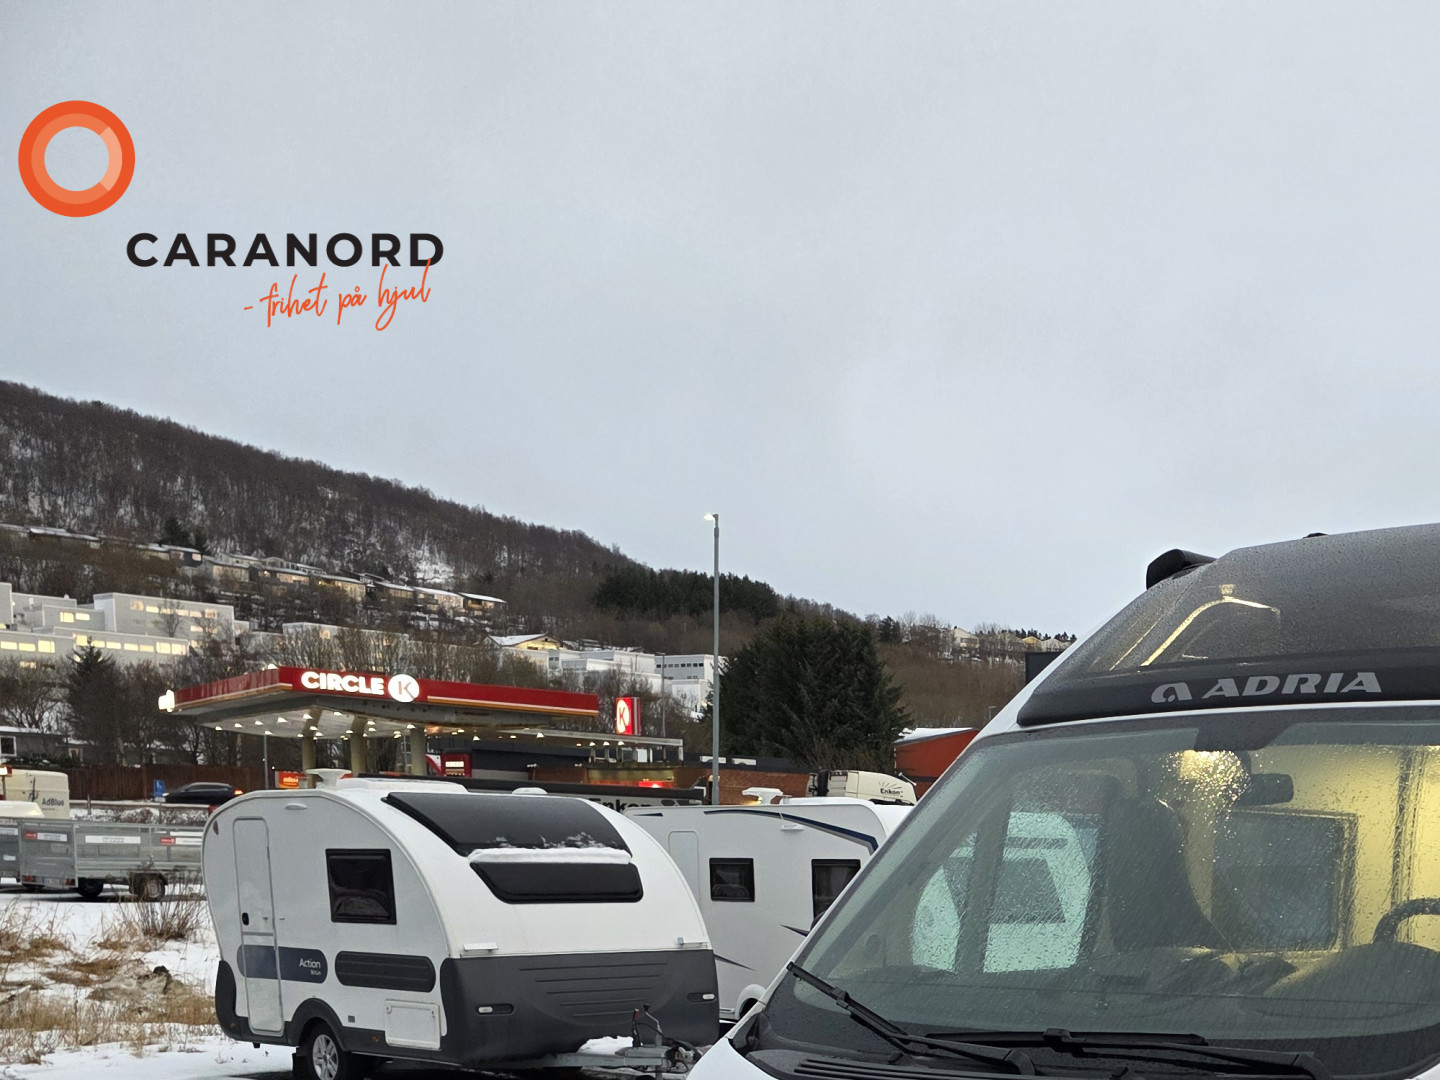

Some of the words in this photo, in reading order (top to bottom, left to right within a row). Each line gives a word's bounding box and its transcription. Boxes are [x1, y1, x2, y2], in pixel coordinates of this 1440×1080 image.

[301, 671, 384, 695] CIRCLE
[1201, 672, 1382, 699] ADRIA
[299, 958, 321, 968] Action
